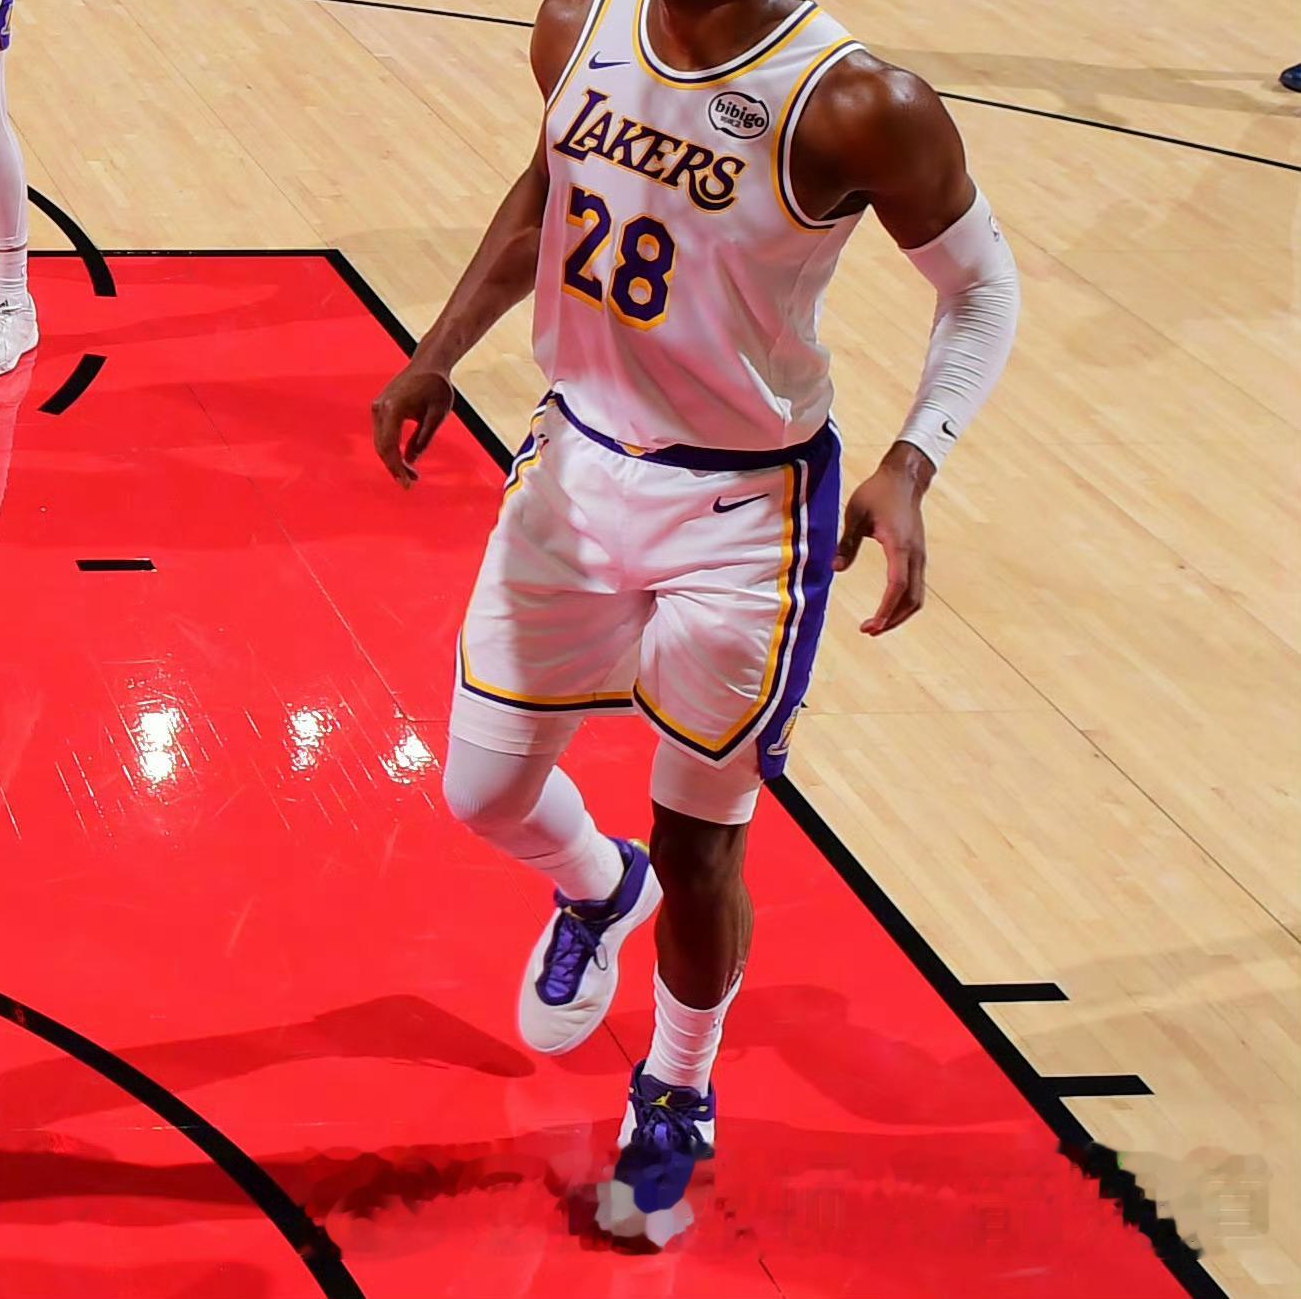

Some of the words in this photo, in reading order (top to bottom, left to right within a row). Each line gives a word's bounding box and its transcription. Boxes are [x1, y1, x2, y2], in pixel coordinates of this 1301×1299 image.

[552, 87, 748, 214] LAKERS
[715, 98, 765, 129] bibigo
[561, 182, 677, 332] 28
